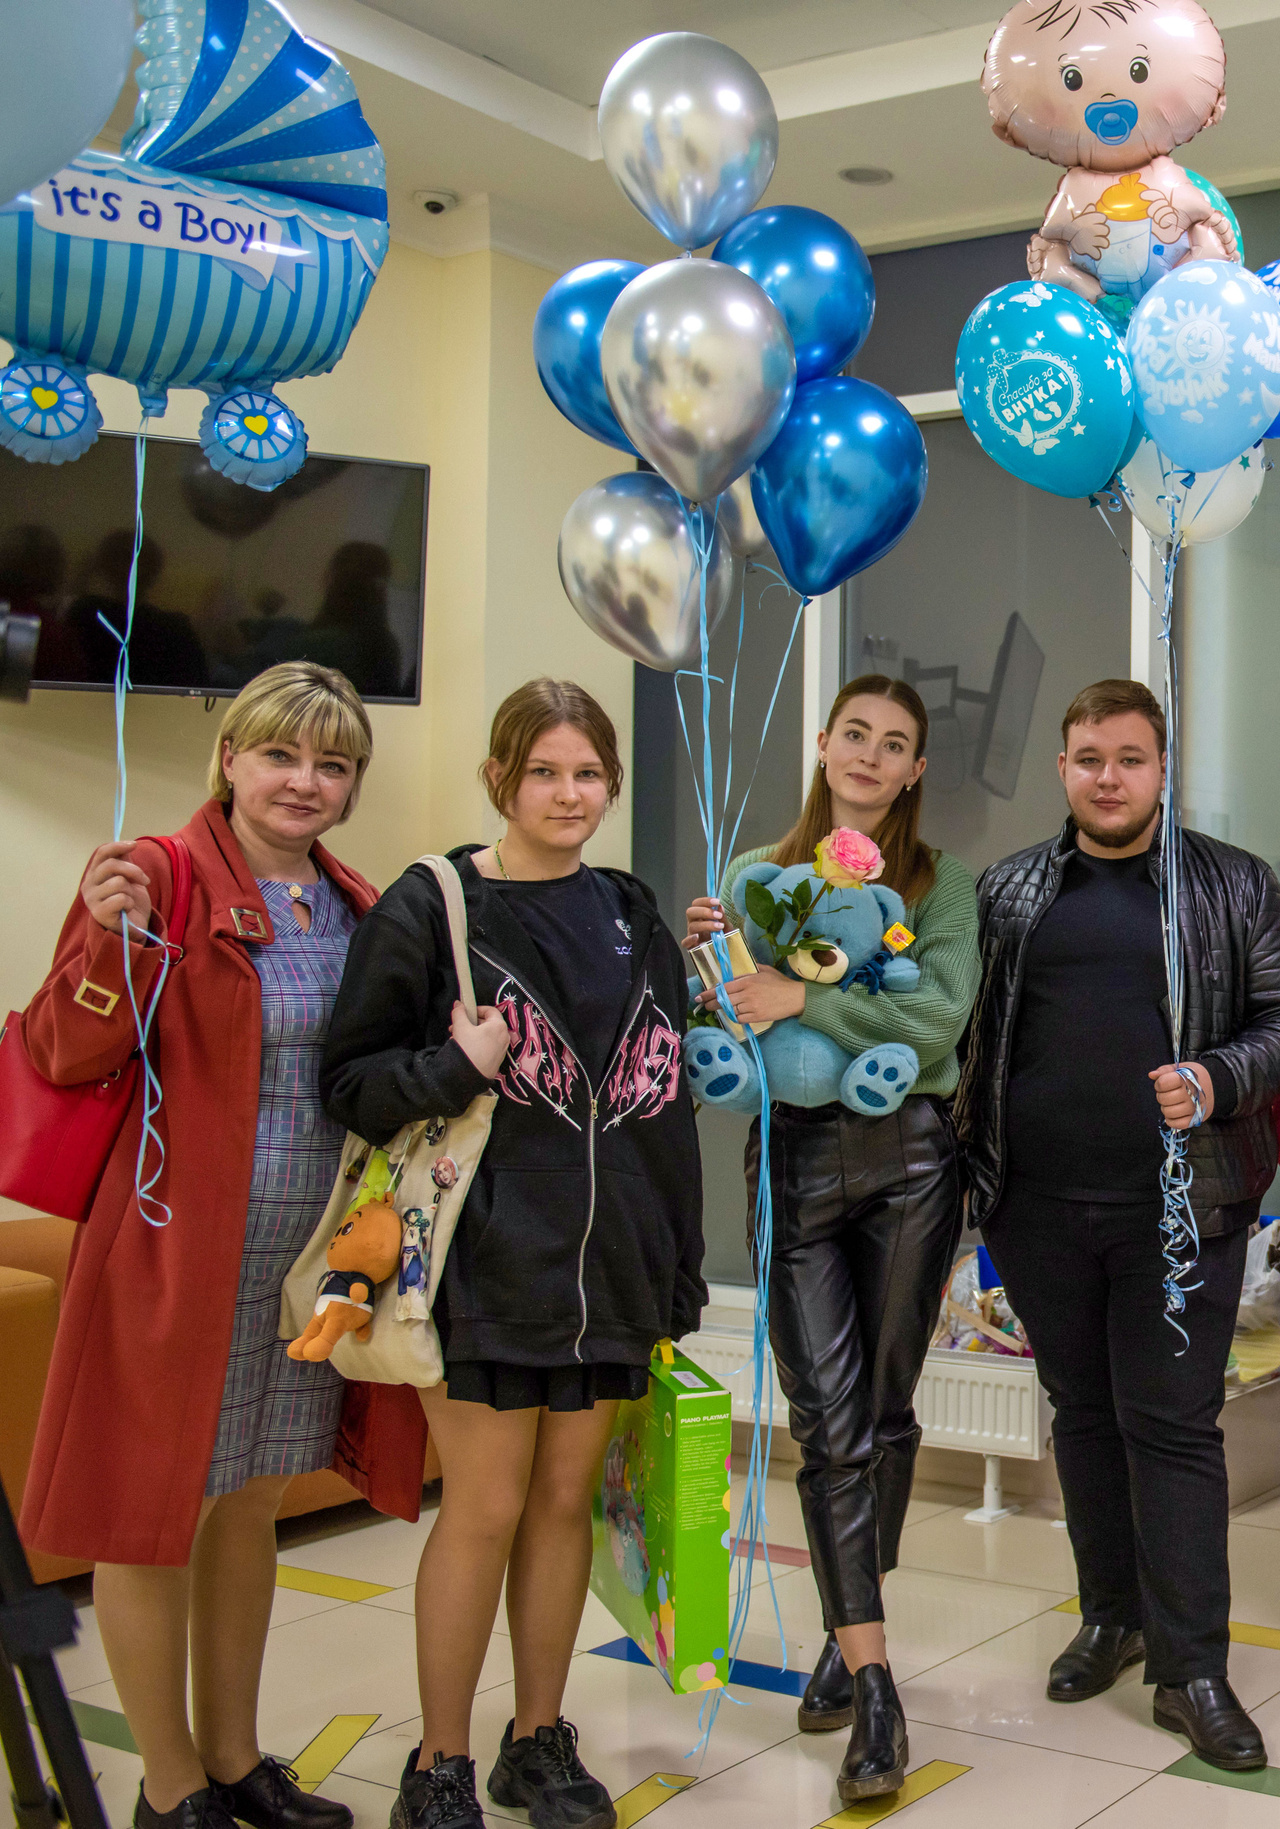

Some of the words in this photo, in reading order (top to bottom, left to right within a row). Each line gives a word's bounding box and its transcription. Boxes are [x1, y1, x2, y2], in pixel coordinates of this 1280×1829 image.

[49, 178, 122, 223] it's
[138, 200, 162, 232] a
[174, 201, 268, 255] Boy!
[998, 374, 1040, 407] Спасибо
[1041, 367, 1054, 381] за
[1001, 372, 1069, 423] ВНУКА!
[680, 1416, 702, 1424] PIANO
[702, 1413, 730, 1421] PLAYMAT
